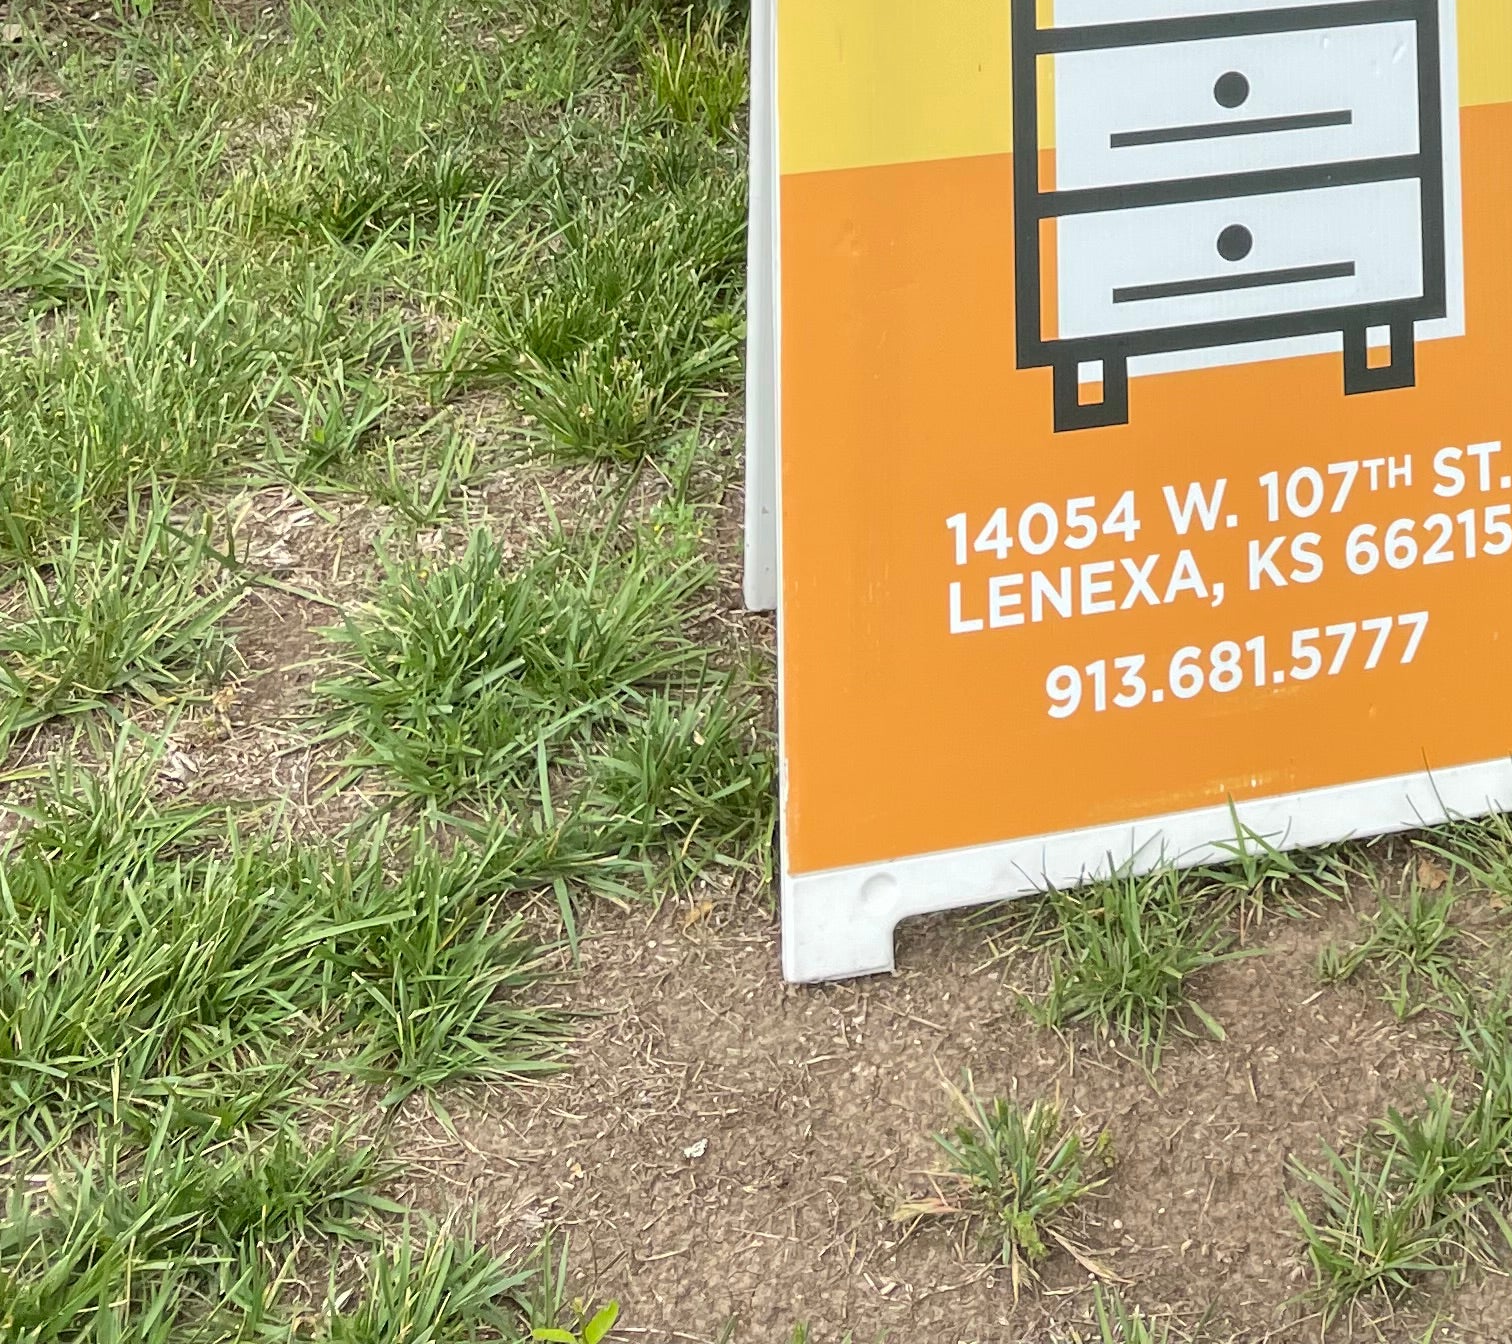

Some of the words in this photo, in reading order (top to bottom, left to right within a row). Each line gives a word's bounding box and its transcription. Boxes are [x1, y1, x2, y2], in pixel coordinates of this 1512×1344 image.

[945, 490, 1141, 566] 14054
[1162, 478, 1238, 535] W.
[1258, 454, 1412, 522] 107TH
[1433, 440, 1512, 498] ST.
[949, 549, 1225, 635] LENEXA,
[1248, 531, 1324, 591] KS
[1045, 611, 1429, 719] 913.681.5777
